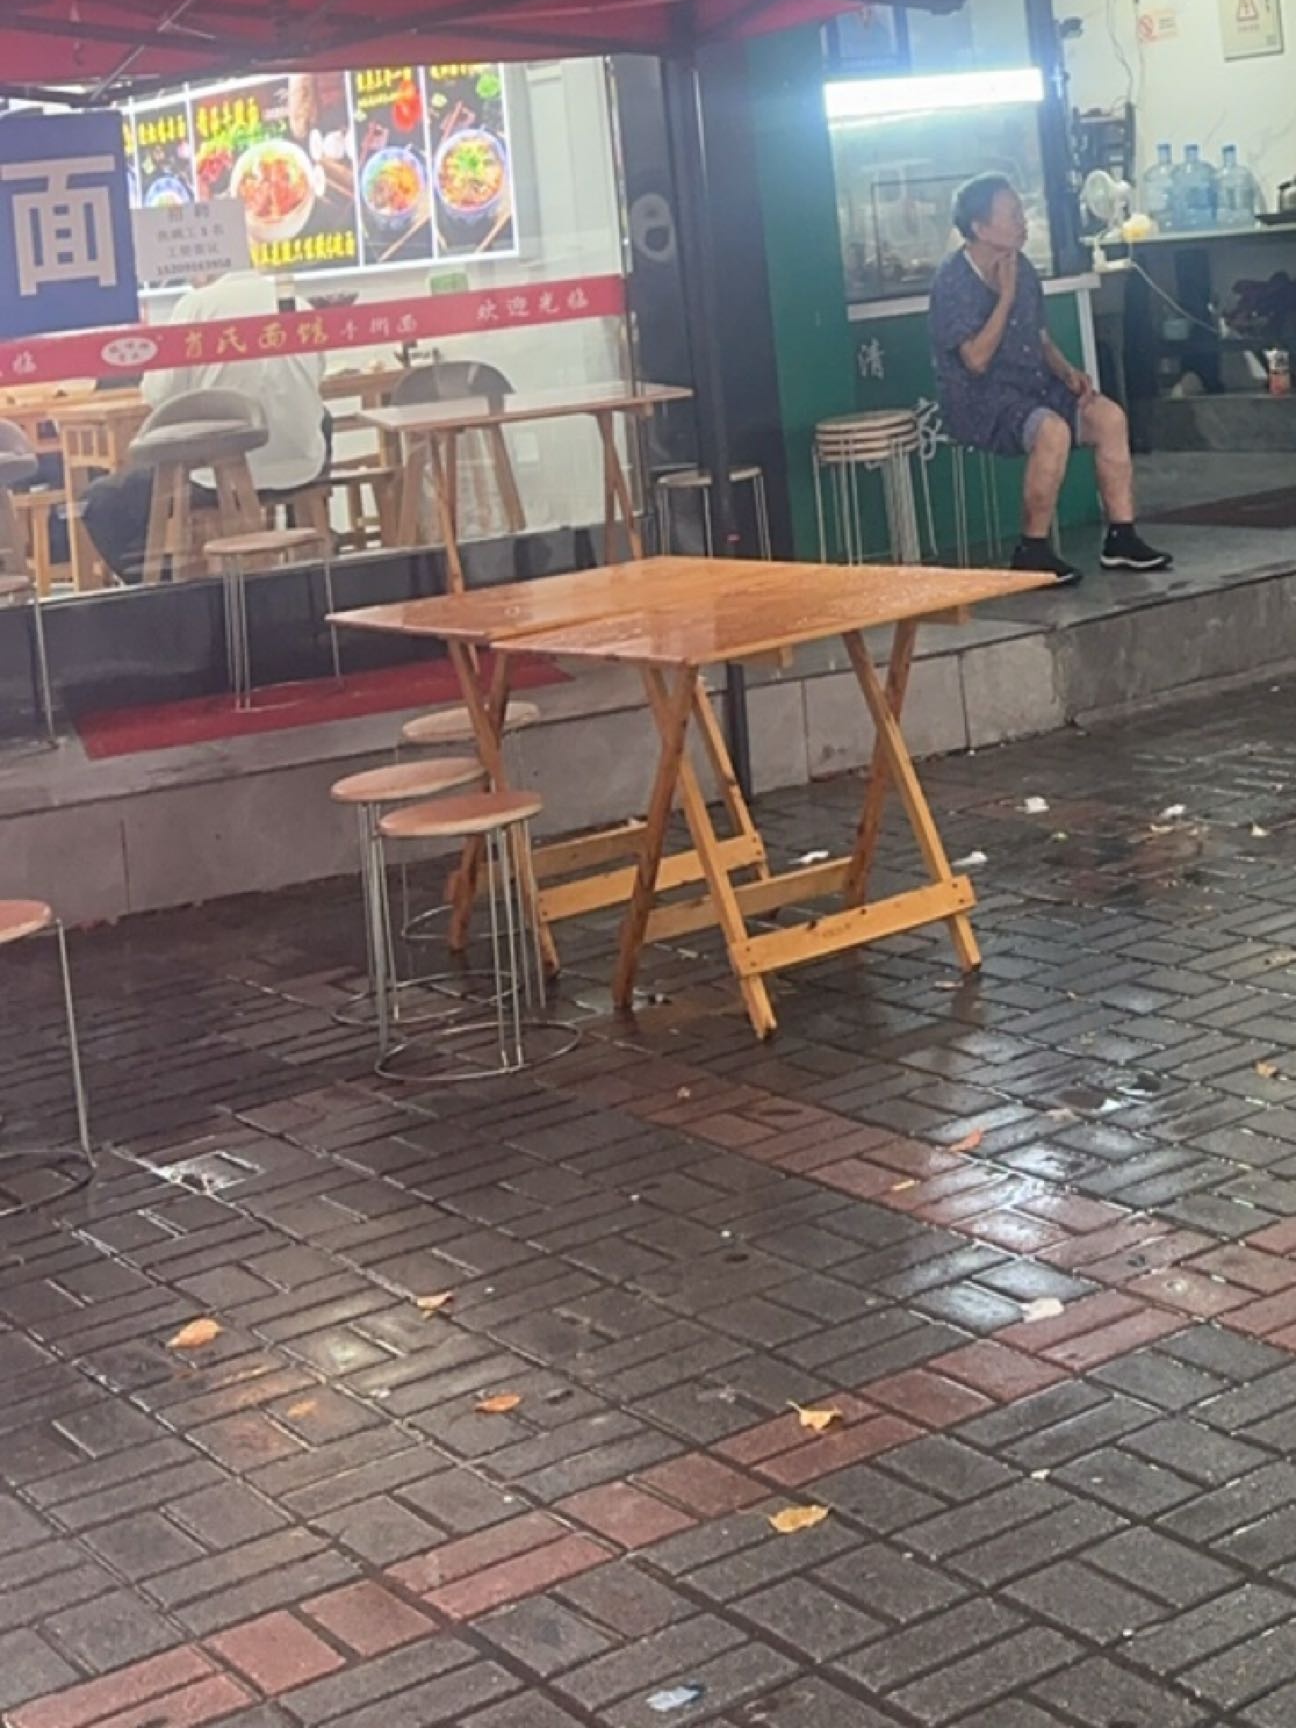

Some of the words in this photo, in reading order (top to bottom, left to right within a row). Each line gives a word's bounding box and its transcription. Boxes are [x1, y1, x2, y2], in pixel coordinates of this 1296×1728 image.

[0, 155, 117, 296] 面
[476, 287, 590, 322] 欢迎光临
